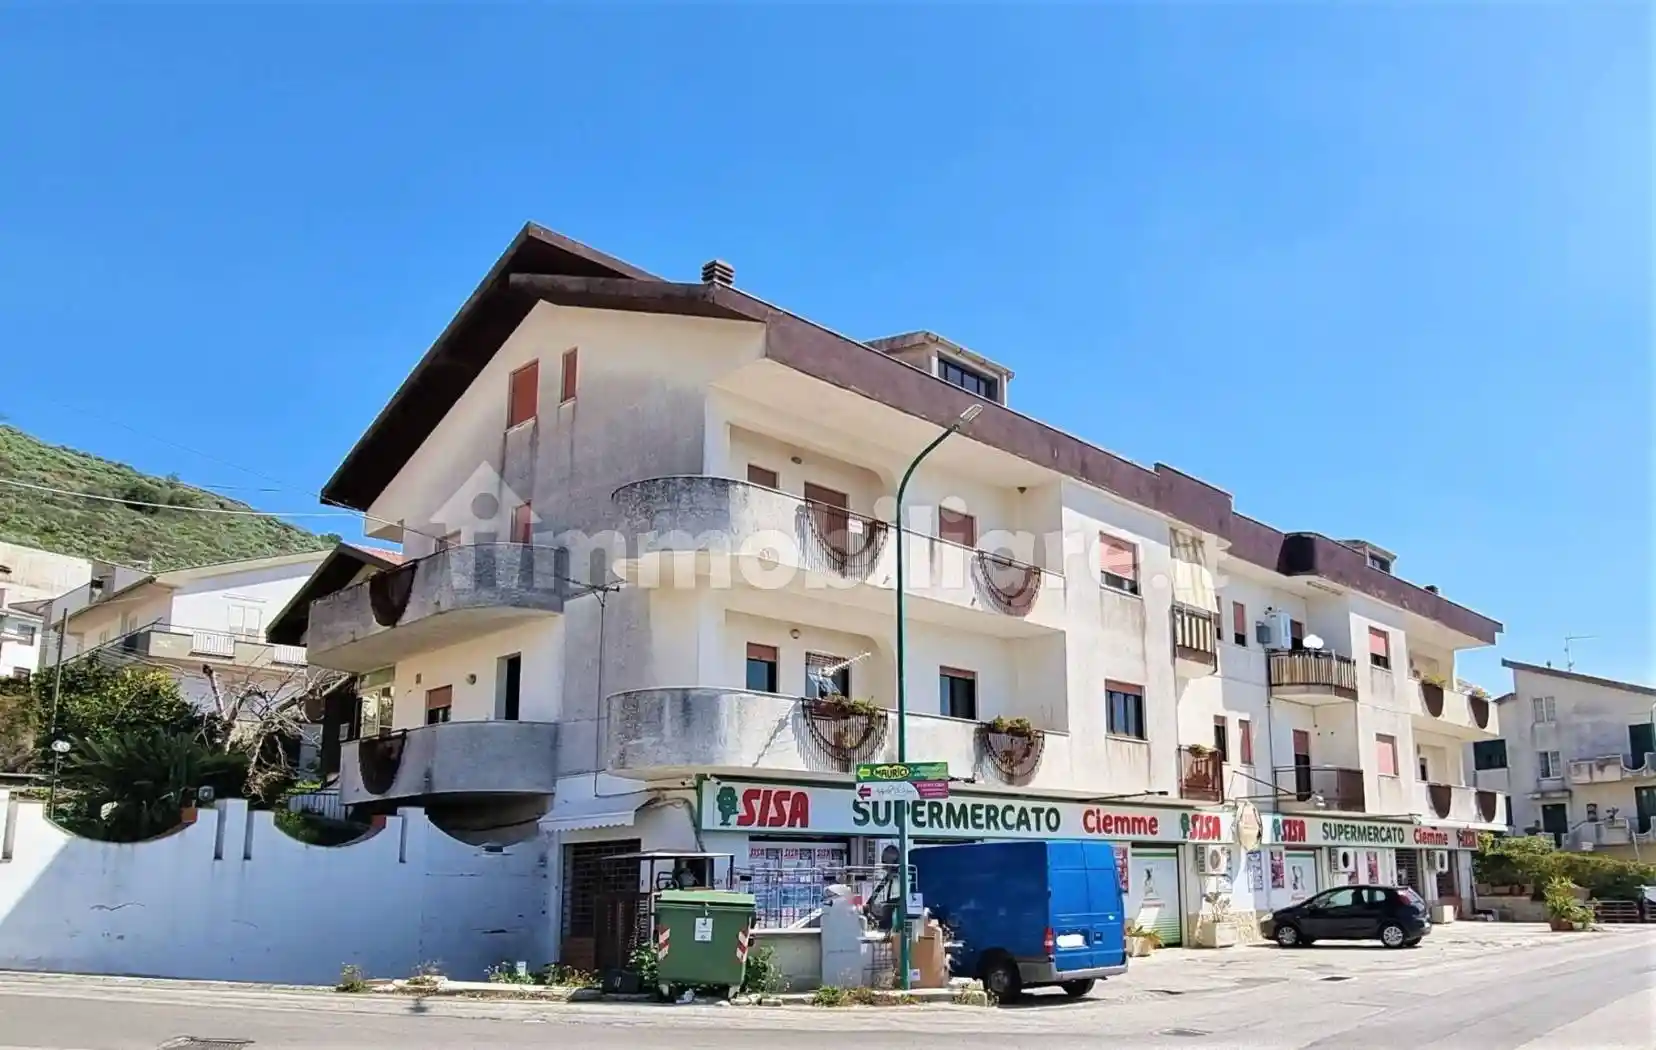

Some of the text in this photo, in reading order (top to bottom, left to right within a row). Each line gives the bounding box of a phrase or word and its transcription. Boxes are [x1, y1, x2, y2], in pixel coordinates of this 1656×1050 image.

[737, 788, 809, 828] SISA
[852, 799, 1061, 833] SUPERMERCATO
[1189, 813, 1221, 841] SISA
[1281, 819, 1306, 842] SISA
[1322, 822, 1405, 844] SUPERMERCATO
